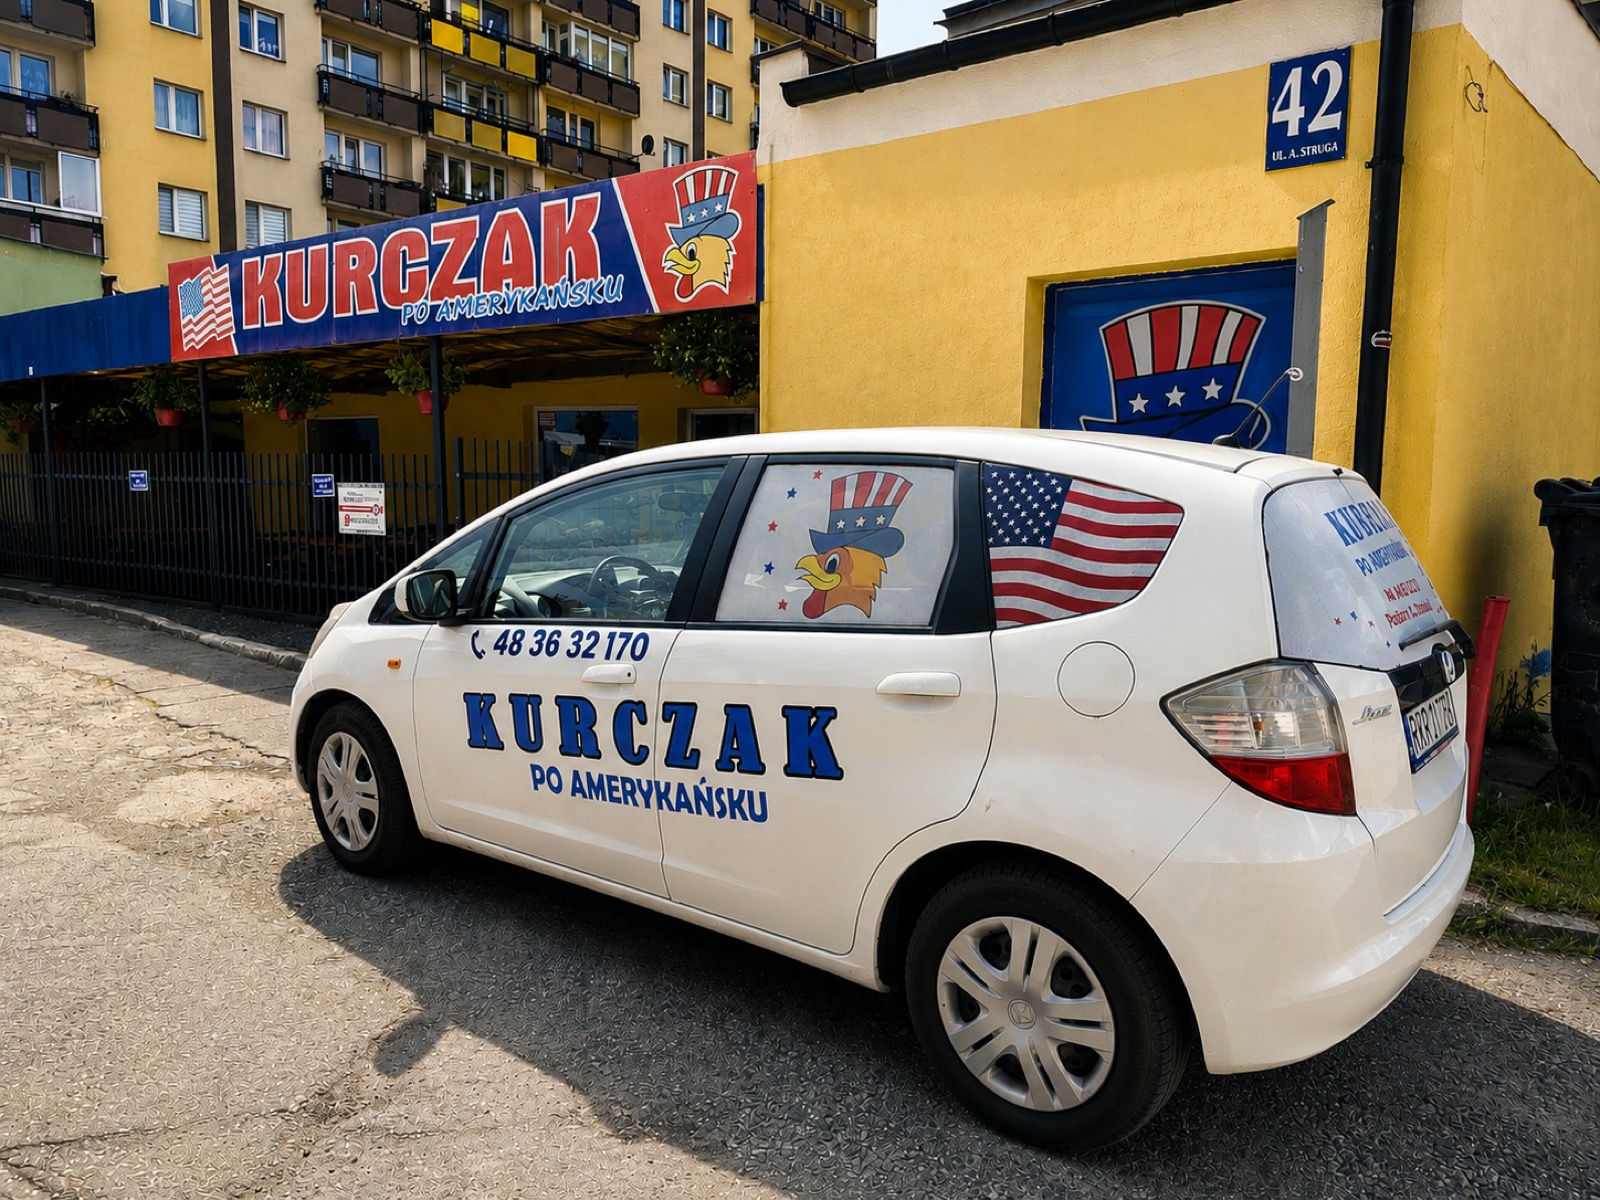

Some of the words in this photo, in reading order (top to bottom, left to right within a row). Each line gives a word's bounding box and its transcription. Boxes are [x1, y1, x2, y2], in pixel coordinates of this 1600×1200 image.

[1272, 60, 1343, 136] 42
[1288, 148, 1299, 159] A.
[1300, 141, 1338, 157] STRUGA
[242, 192, 601, 329] KURCZAK
[401, 302, 430, 325] PO
[435, 274, 625, 322] AMERYKAŃSKU
[493, 629, 525, 657] 48
[529, 629, 562, 657] 36
[566, 630, 600, 659] 32
[604, 631, 649, 662] 170
[463, 692, 844, 780] KURCZAK
[530, 764, 563, 794] PO
[571, 769, 768, 823] AMERYKAŃSKU
